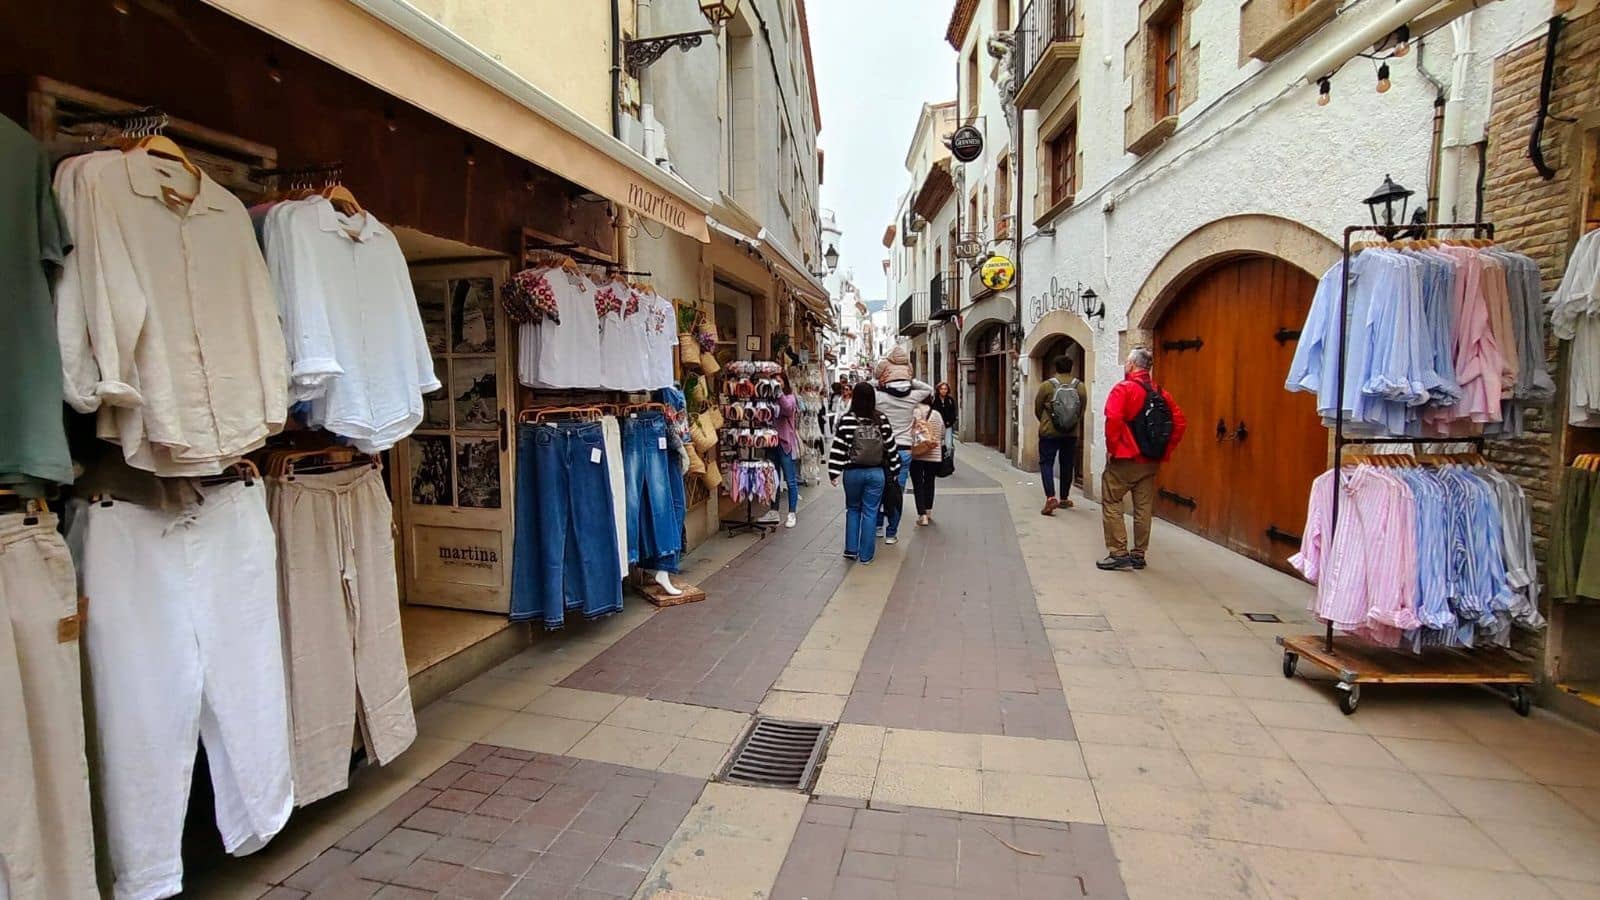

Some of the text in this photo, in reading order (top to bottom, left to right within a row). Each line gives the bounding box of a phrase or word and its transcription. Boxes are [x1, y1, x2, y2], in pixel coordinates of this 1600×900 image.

[628, 183, 686, 230] martina
[956, 243, 980, 255] PUB
[439, 546, 498, 562] martina
